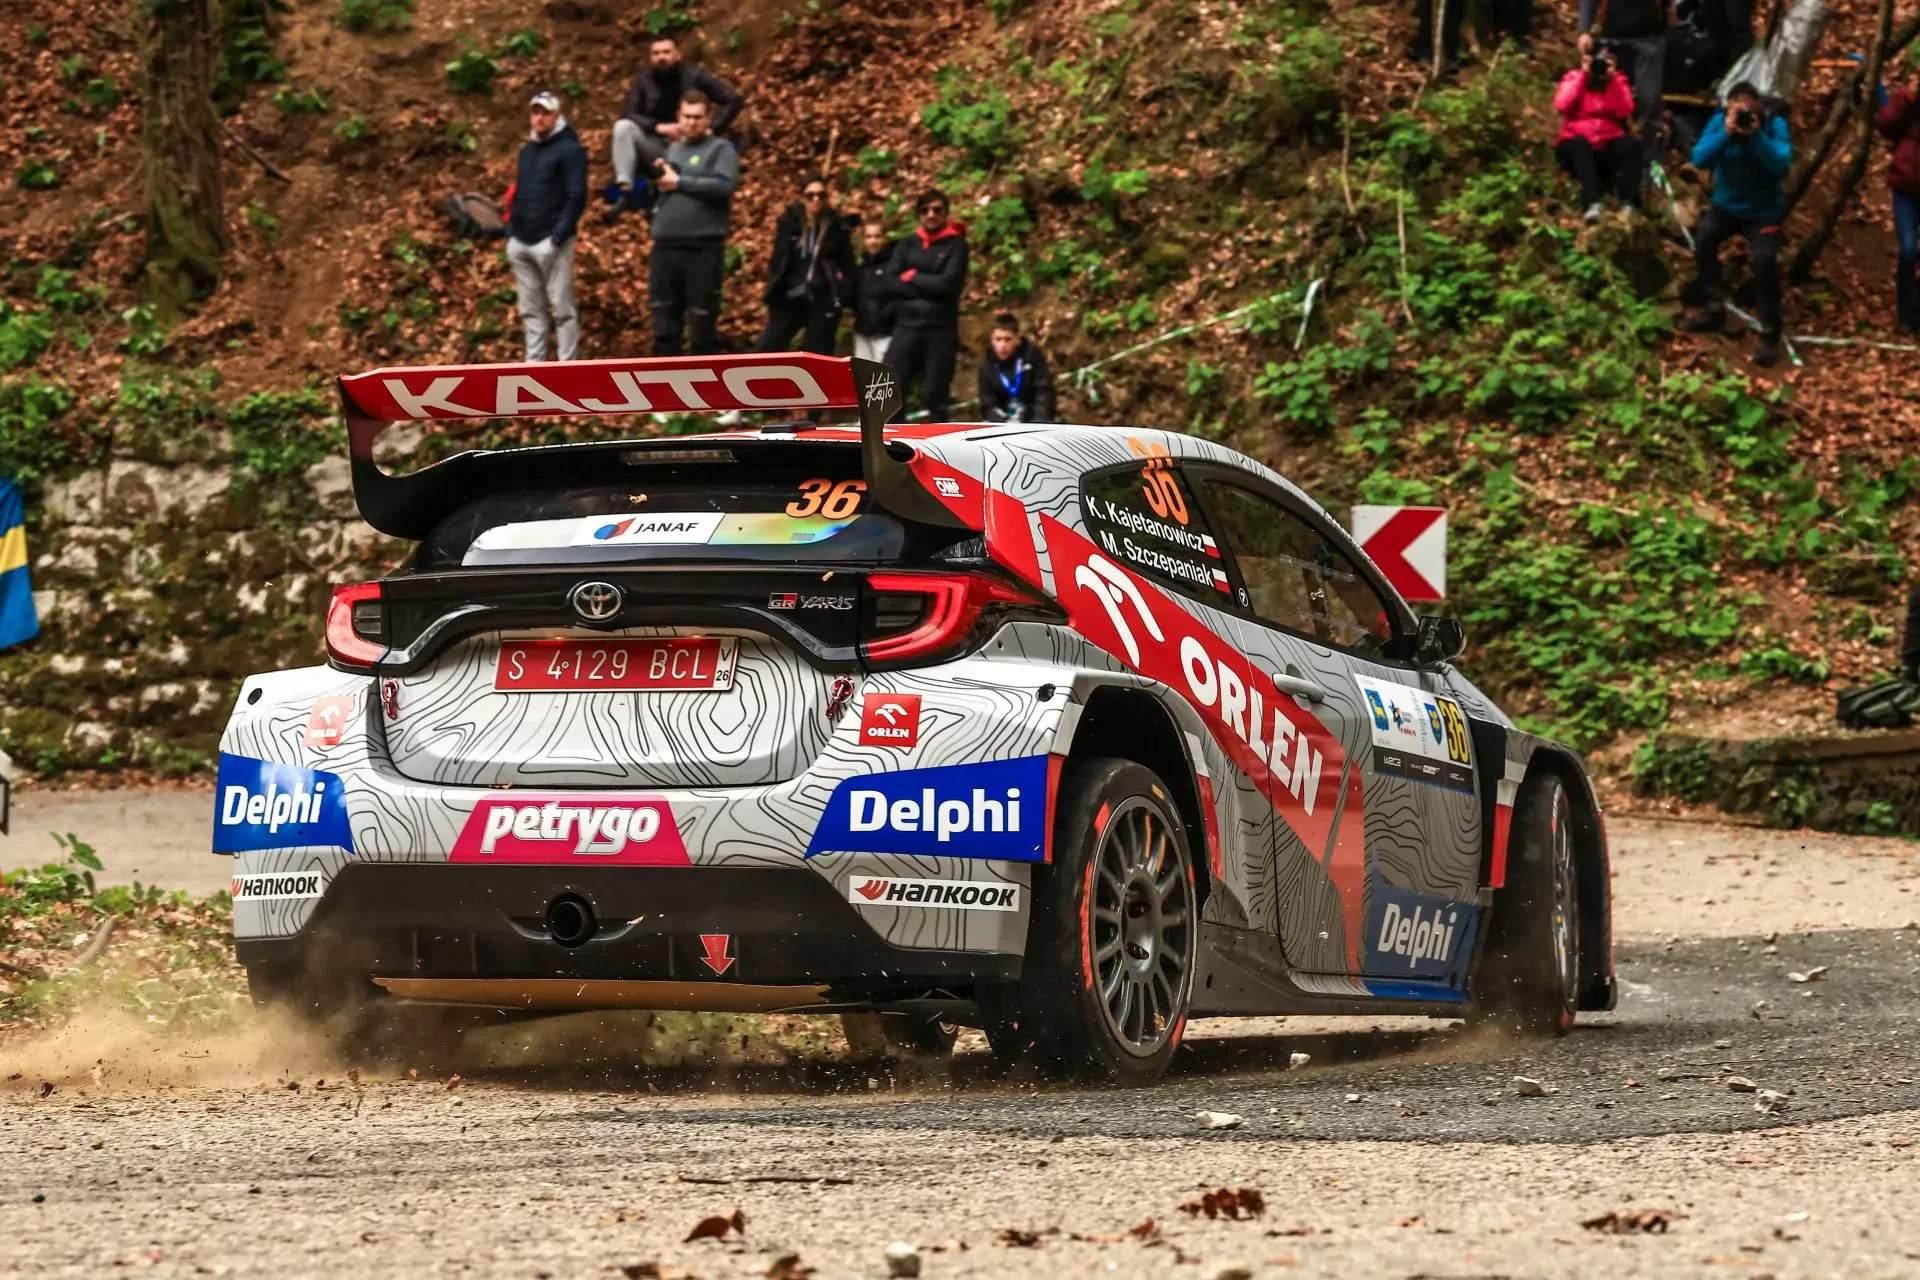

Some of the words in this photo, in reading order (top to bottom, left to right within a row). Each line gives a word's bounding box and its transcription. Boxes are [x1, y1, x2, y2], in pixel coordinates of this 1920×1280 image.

[381, 364, 830, 418] KAJTO
[784, 477, 868, 520] 36
[935, 480, 960, 495] OMP
[632, 521, 699, 535] JANAF
[1085, 494, 1107, 520] K.
[1104, 500, 1206, 553] Kajetanowicz
[1099, 529, 1123, 557] M.
[1123, 537, 1215, 588] Szczepaniak
[770, 599, 794, 608] GR
[800, 595, 856, 610] YARIS
[508, 650, 527, 680] S
[547, 649, 628, 680] 4129
[649, 649, 708, 680] BCL
[715, 670, 730, 682] 26
[720, 648, 732, 662] V
[867, 727, 910, 738] ORLEN
[1180, 635, 1323, 817] ORLEN
[1437, 699, 1469, 763] 36
[221, 782, 325, 834] Delphi
[480, 801, 660, 856] petrygo
[849, 787, 1022, 843] Delphi
[1376, 903, 1458, 968] Delphi
